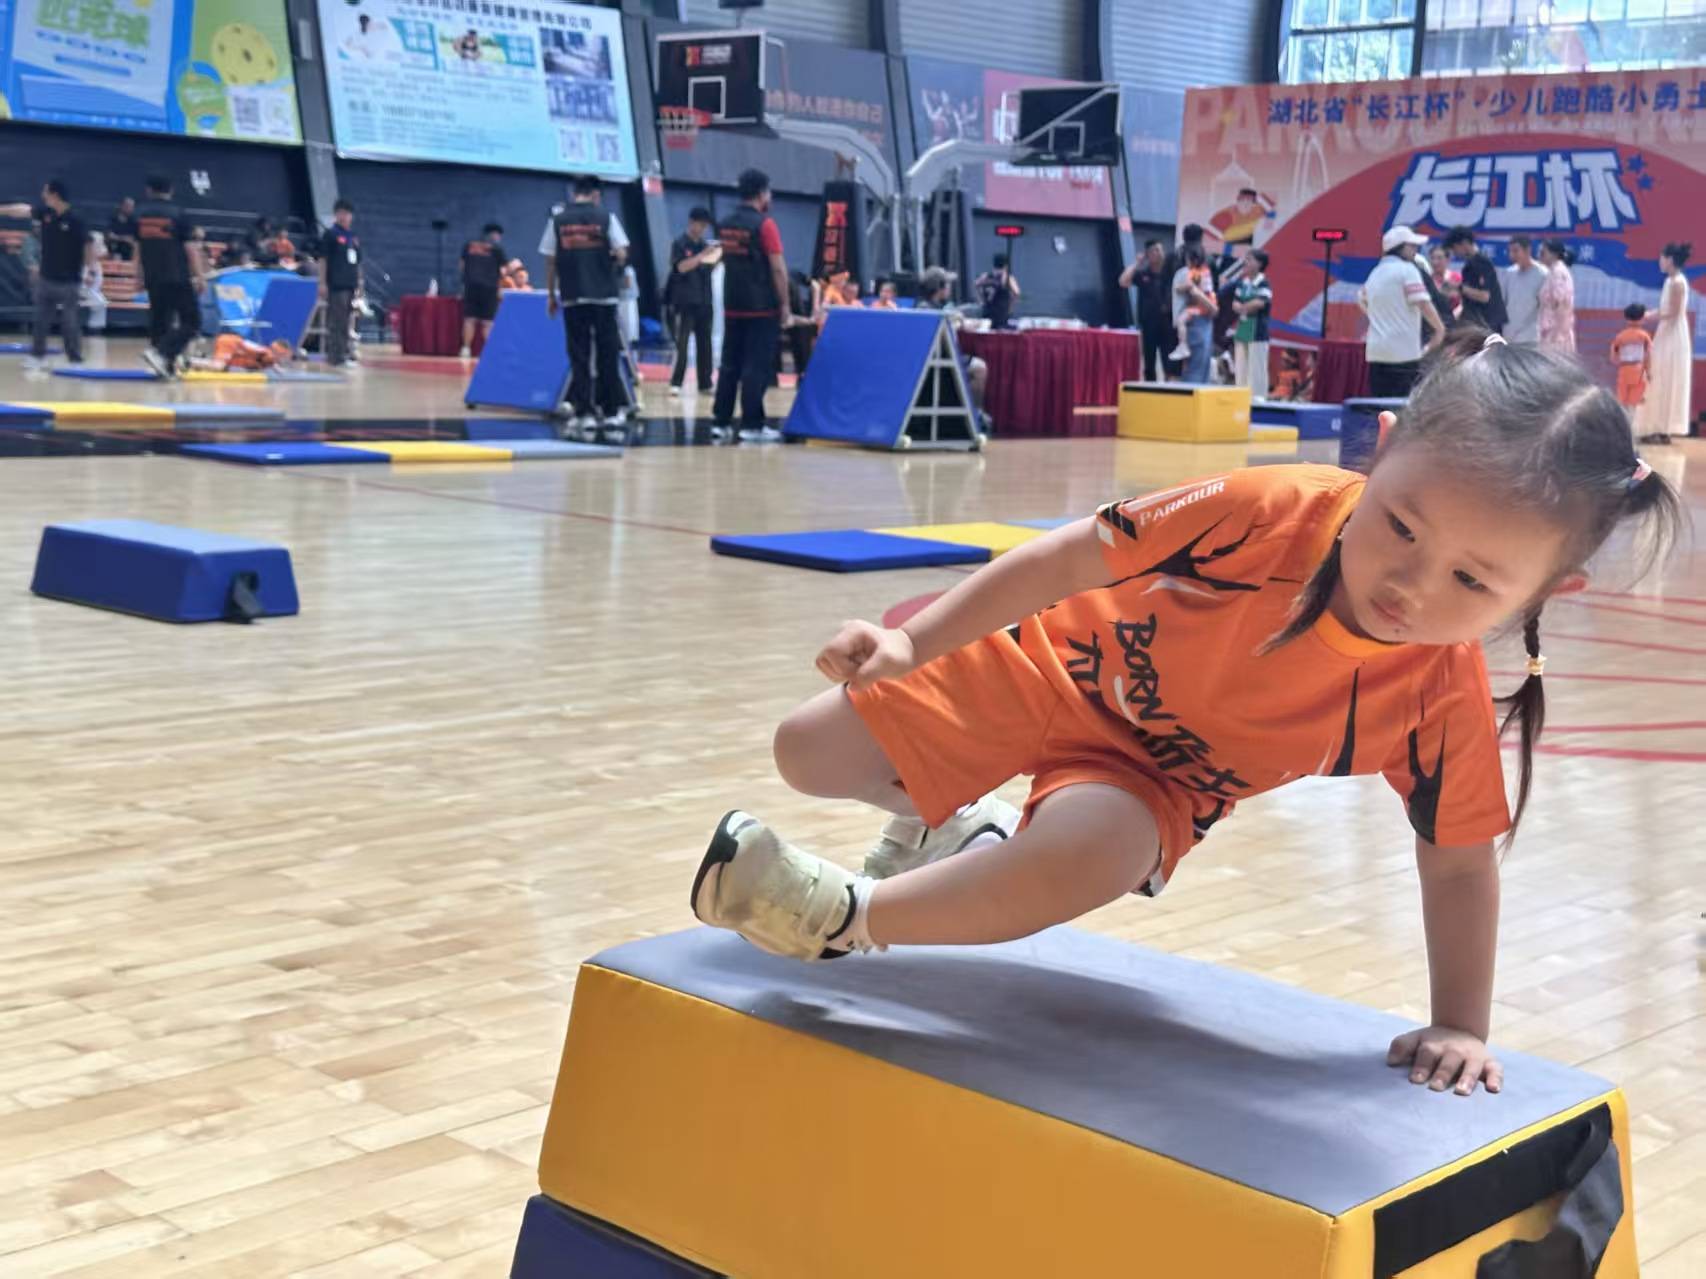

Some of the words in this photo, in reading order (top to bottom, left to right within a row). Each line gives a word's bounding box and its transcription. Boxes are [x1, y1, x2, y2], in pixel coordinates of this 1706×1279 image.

[1396, 150, 1638, 231] 长江杯
[1139, 481, 1225, 526] PARKOUR
[1107, 613, 1181, 721] BORN
